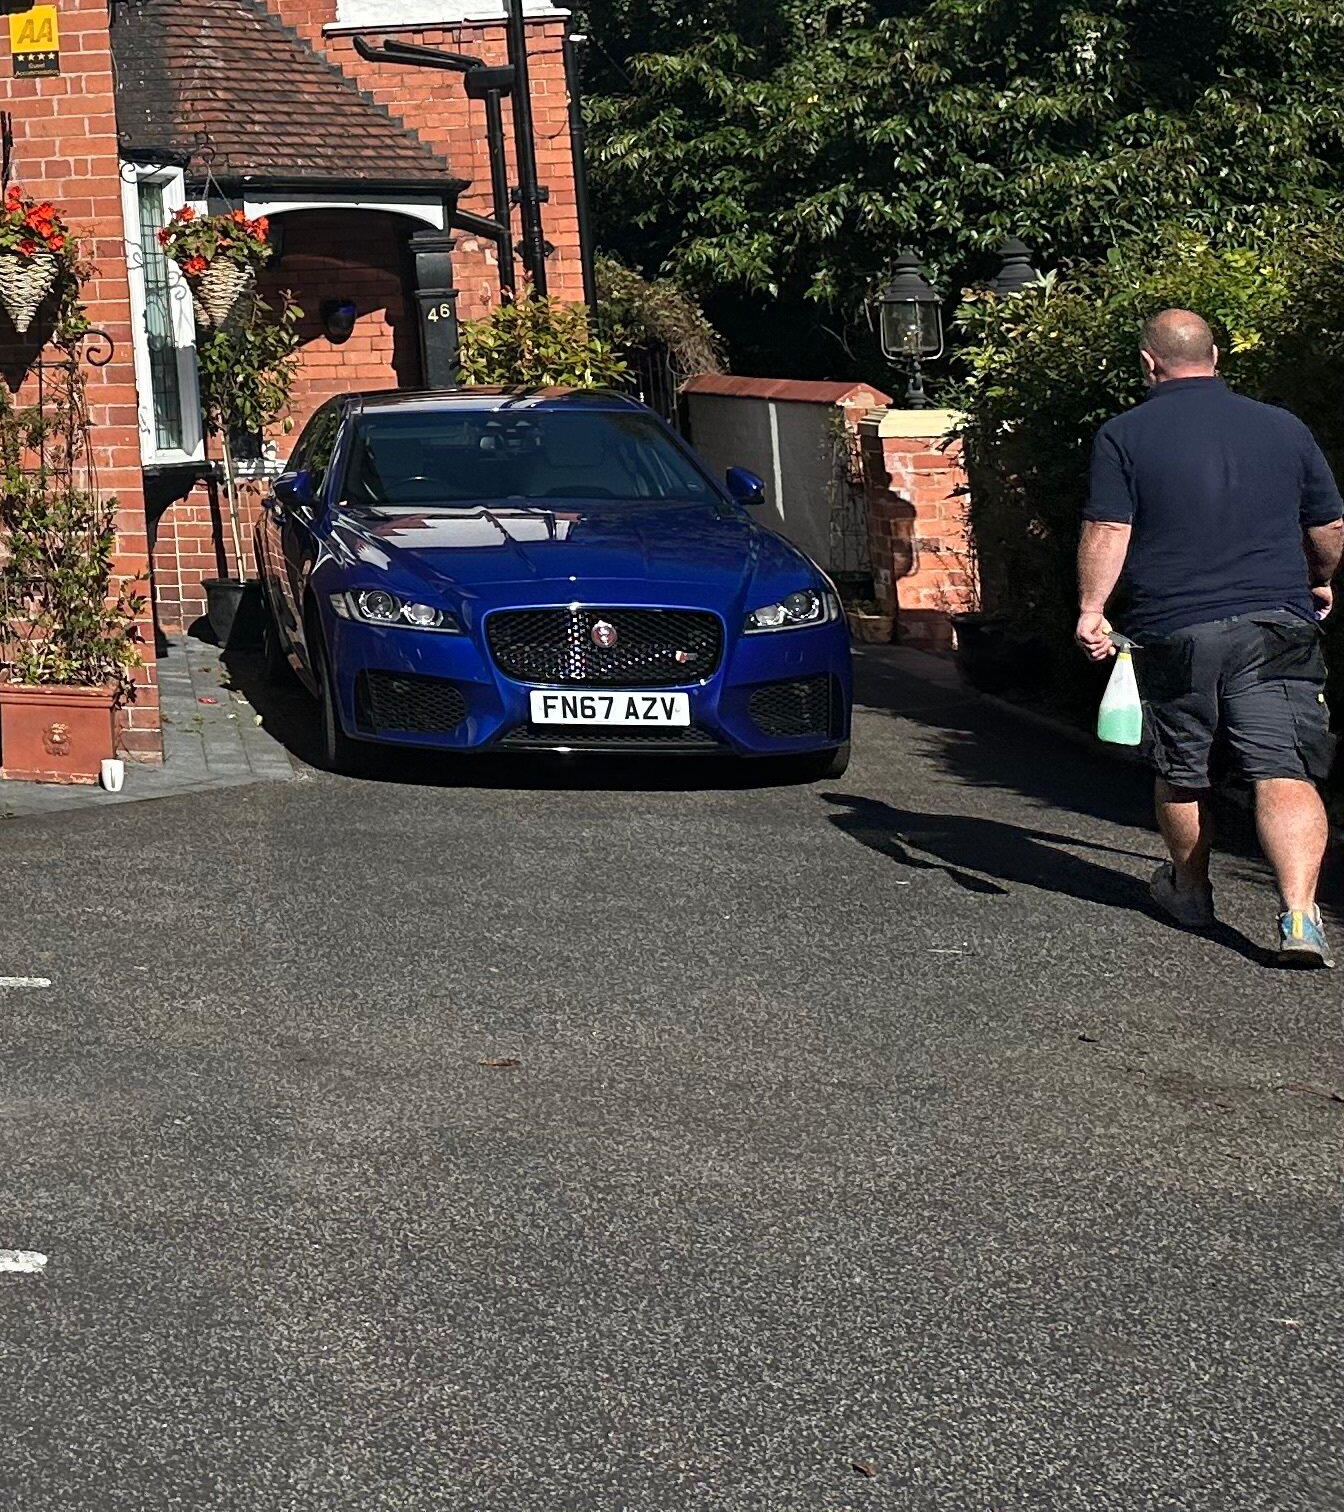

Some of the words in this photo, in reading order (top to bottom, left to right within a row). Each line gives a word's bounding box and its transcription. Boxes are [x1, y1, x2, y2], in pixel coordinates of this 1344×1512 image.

[17, 17, 53, 44] AA
[427, 303, 451, 323] 46
[542, 695, 614, 720] FN67
[624, 696, 676, 721] AZV
